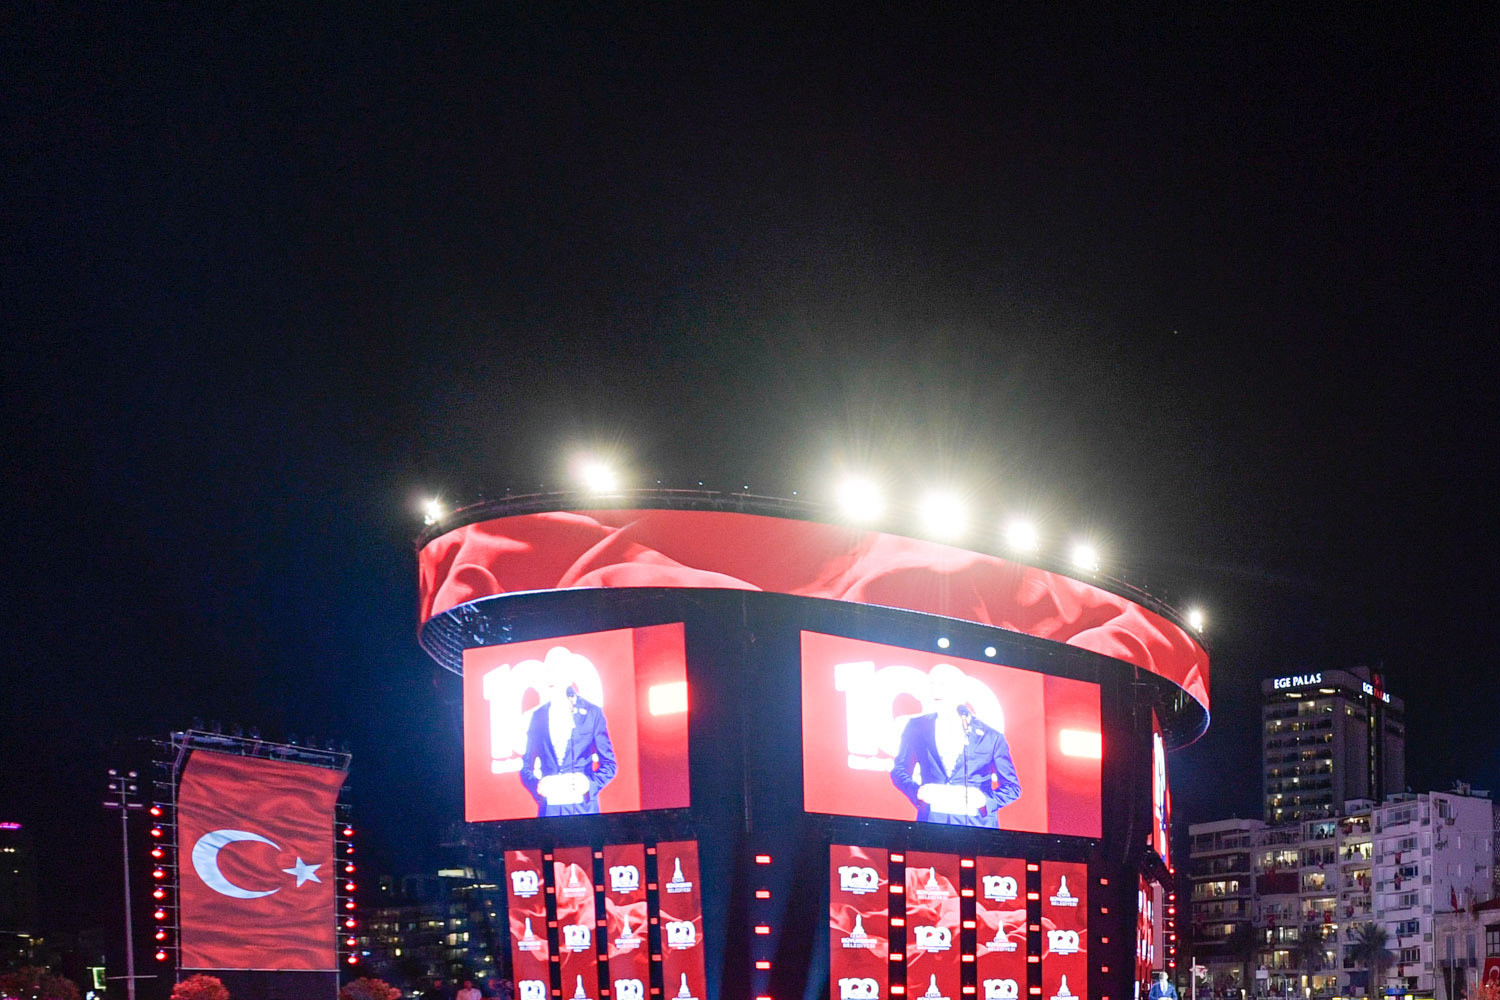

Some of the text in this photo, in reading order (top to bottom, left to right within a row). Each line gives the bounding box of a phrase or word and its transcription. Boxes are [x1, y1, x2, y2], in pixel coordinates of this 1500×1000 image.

[1274, 673, 1322, 689] EGE PALAS
[1362, 682, 1374, 696] EGE
